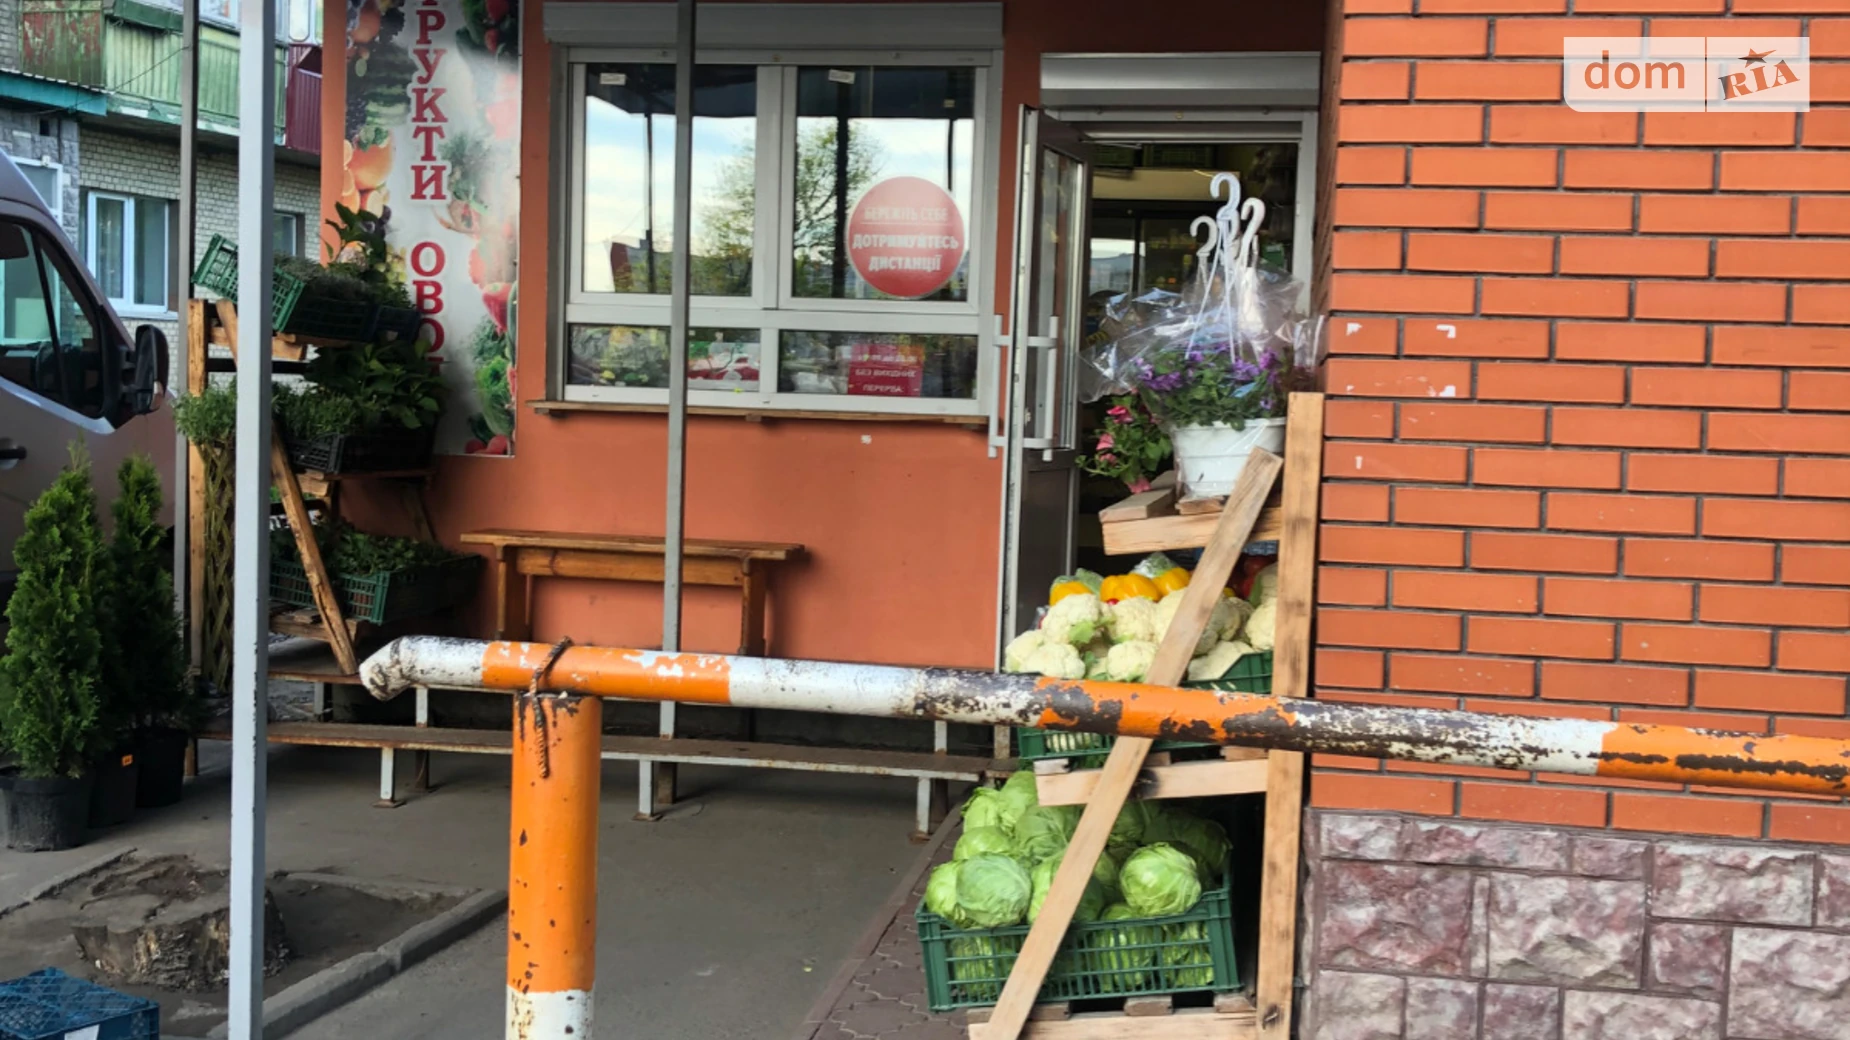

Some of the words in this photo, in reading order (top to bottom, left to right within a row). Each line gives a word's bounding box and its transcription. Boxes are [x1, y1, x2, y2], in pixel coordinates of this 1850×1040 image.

[411, 0, 449, 200] РУКТИ
[852, 232, 959, 250] ДОТРИМУЙТЕСЬ
[868, 255, 942, 272] ДИСТАНЦІЇ
